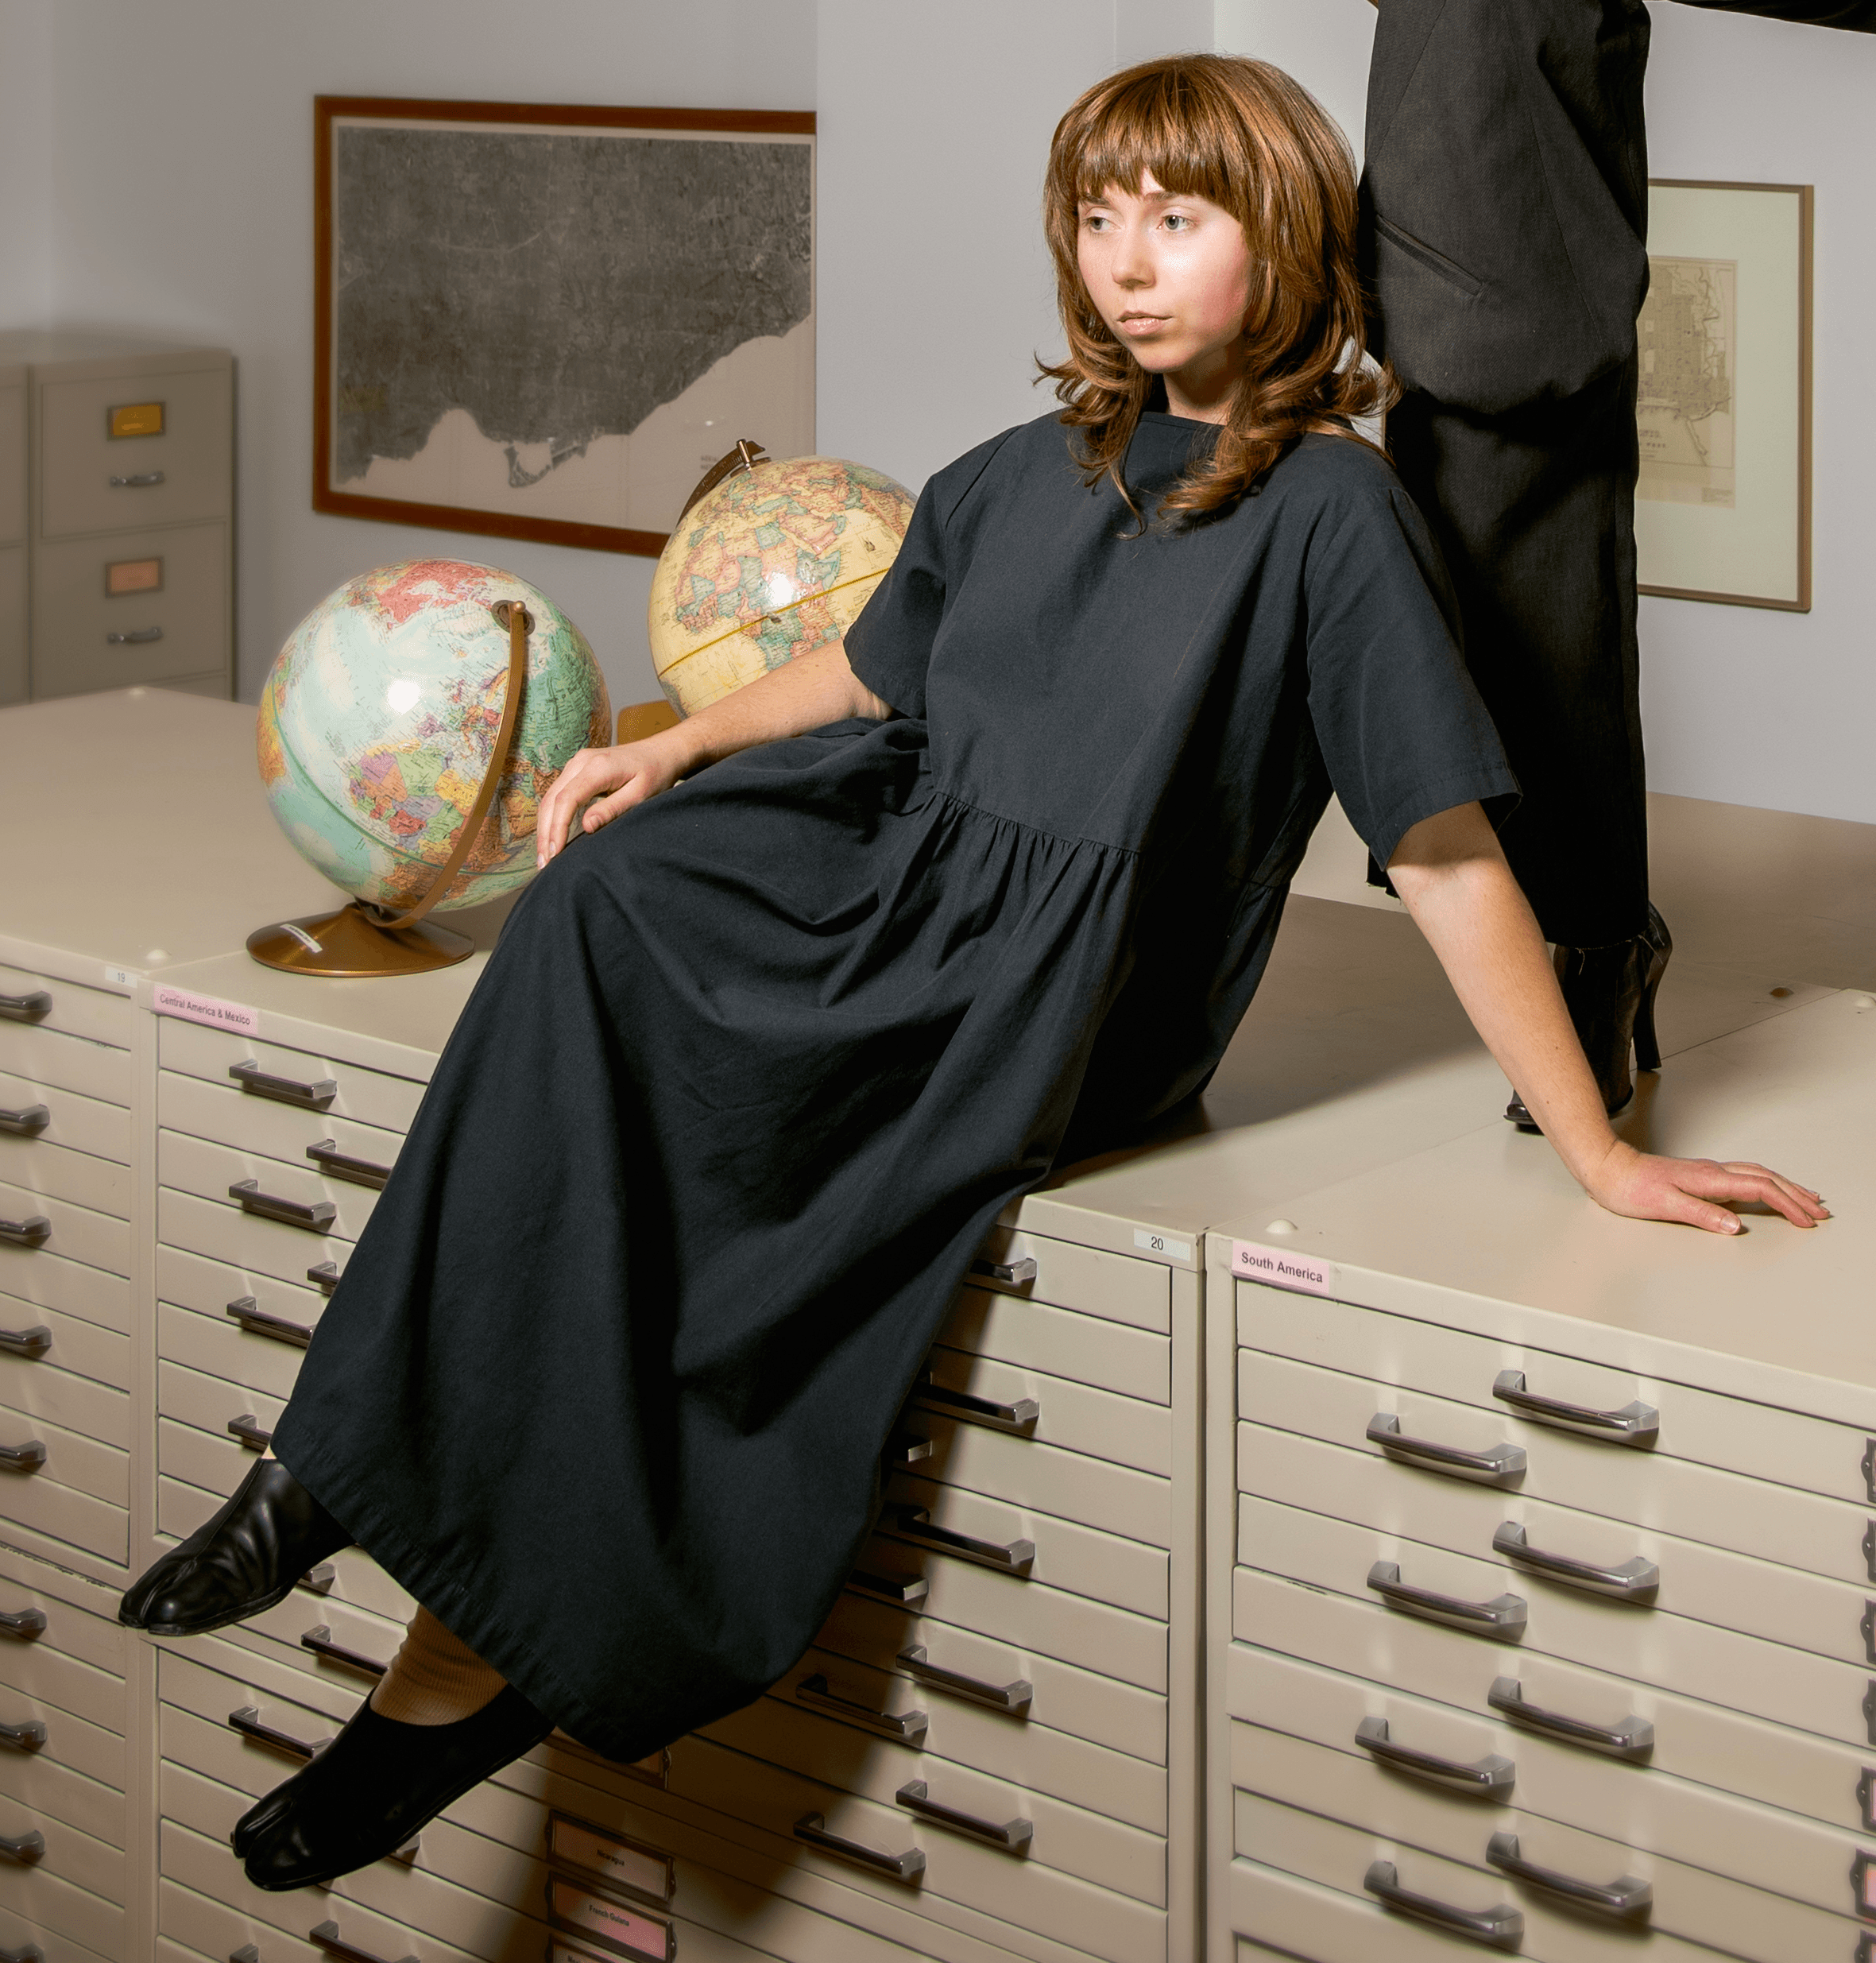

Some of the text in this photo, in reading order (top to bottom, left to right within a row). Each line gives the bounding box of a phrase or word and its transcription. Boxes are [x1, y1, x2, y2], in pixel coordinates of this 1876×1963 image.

[117, 972, 126, 983] 19
[160, 993, 250, 1025] Central America & Mexico
[1151, 1236, 1164, 1251] 20
[1241, 1252, 1323, 1283] South America
[589, 1903, 609, 1918] French
